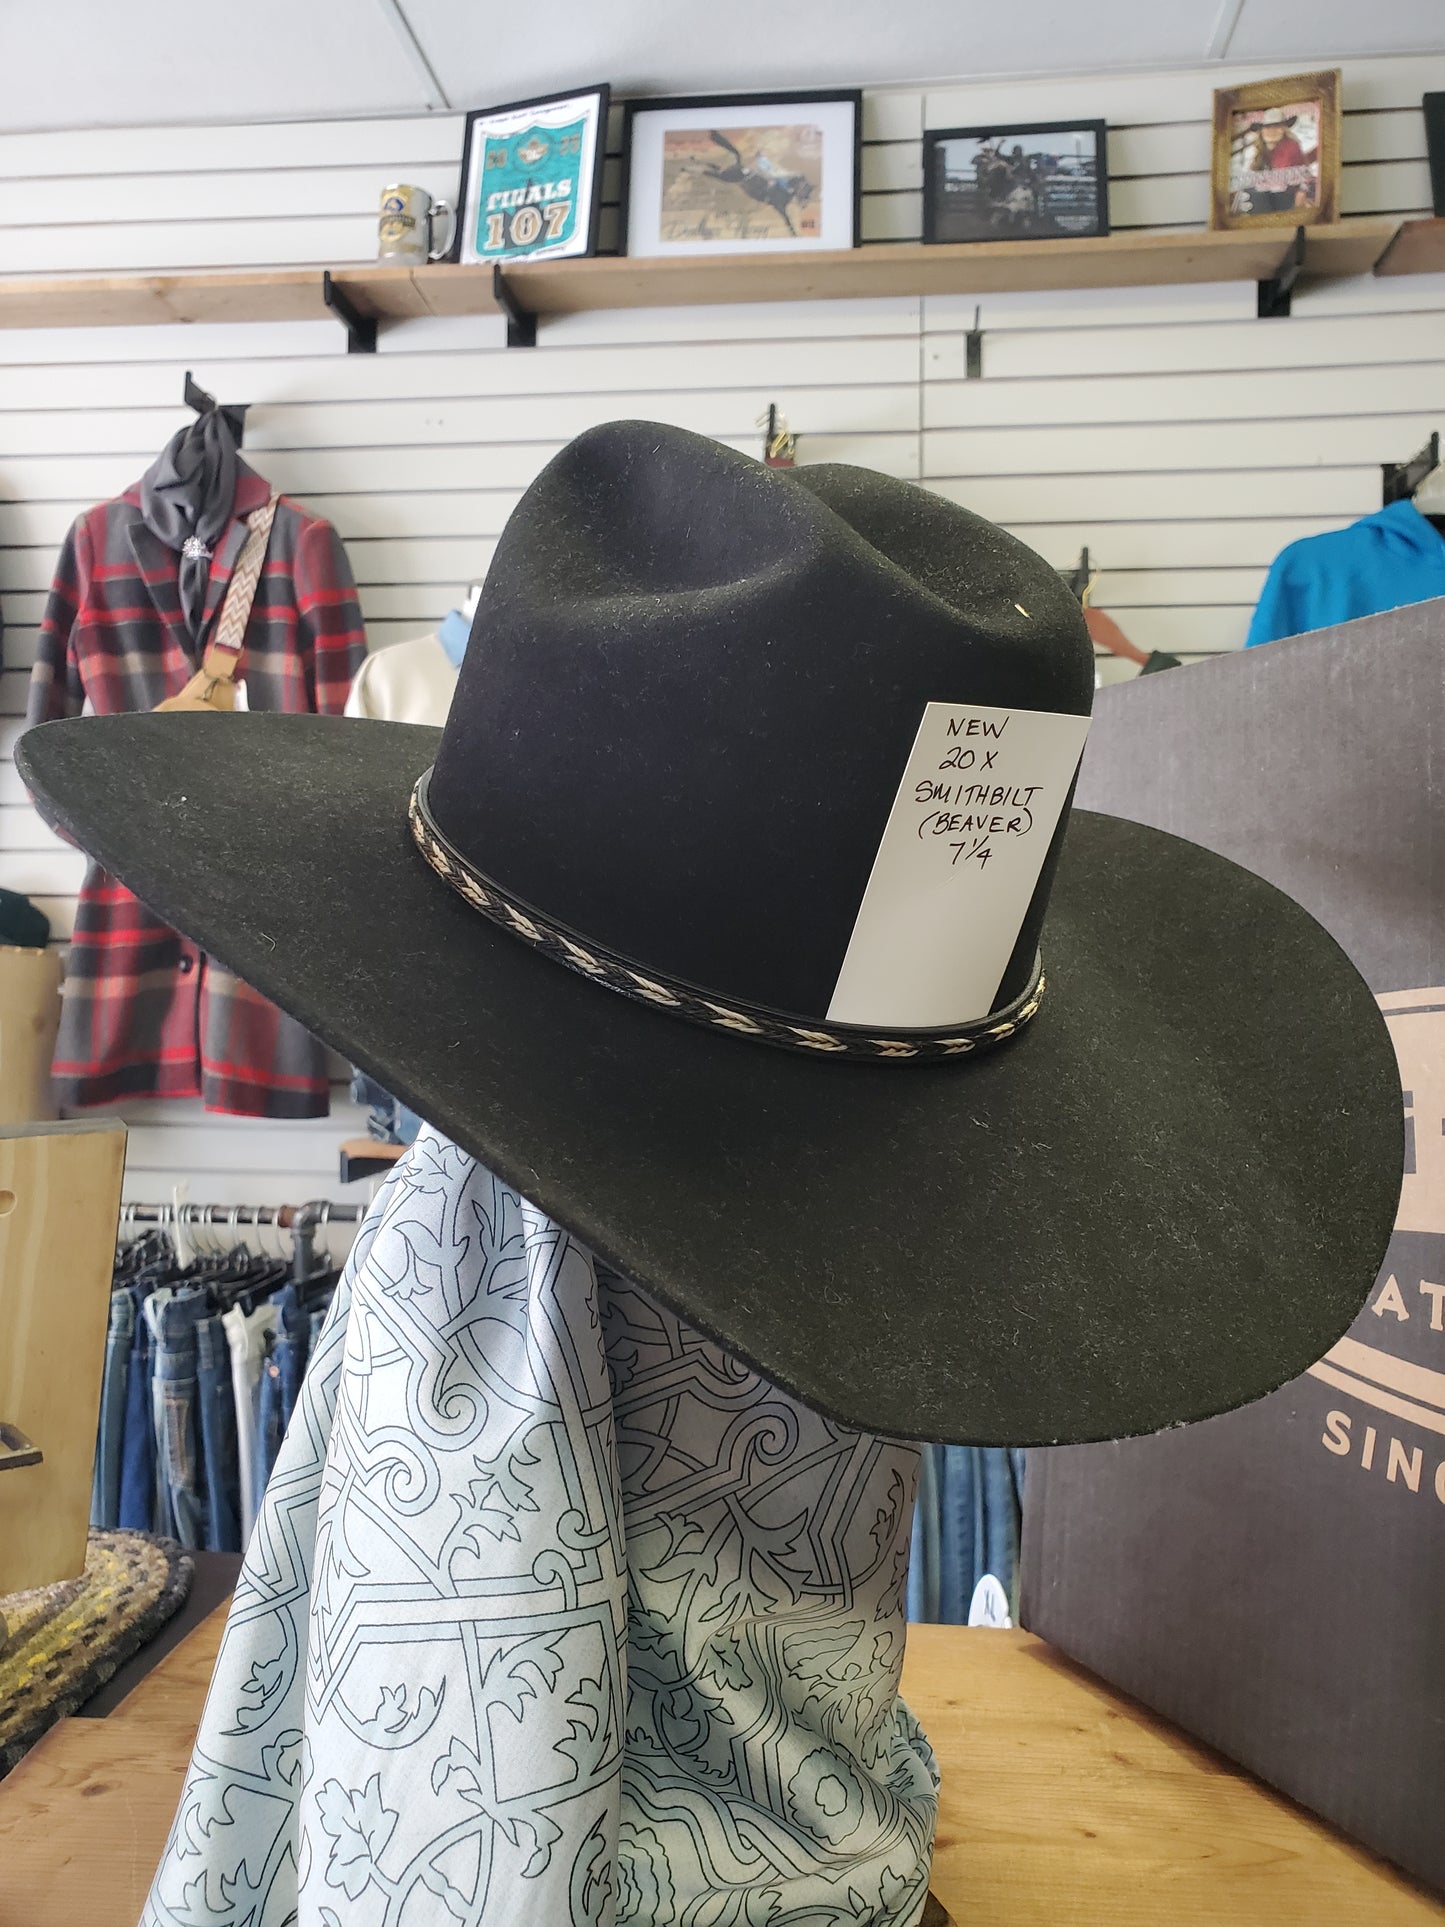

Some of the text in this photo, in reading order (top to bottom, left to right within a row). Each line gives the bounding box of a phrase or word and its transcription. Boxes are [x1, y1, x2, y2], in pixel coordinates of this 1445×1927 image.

[486, 178, 572, 212] FINALS
[483, 200, 572, 251] 107
[946, 716, 1010, 739] NEW
[915, 780, 1044, 807] SMITHBILT
[918, 807, 1033, 840] (BEAVER)
